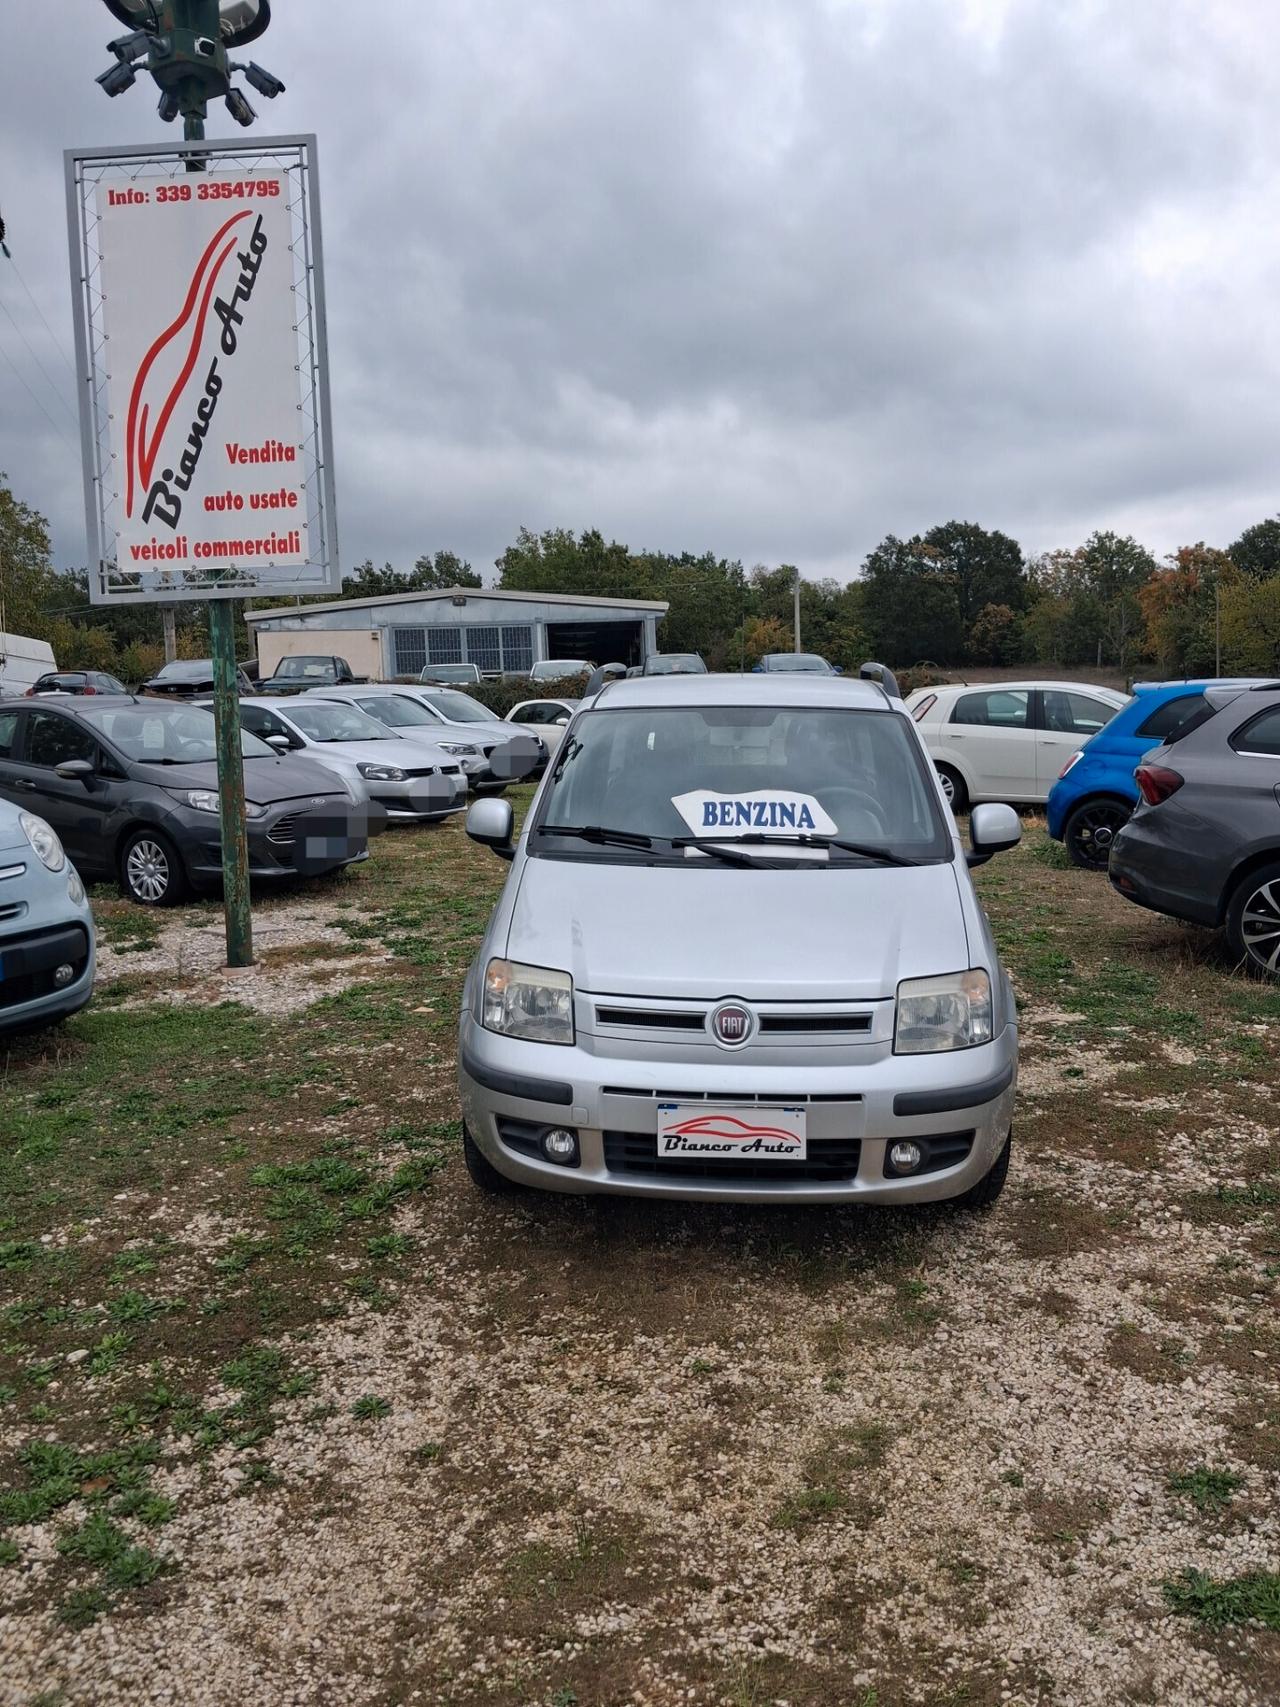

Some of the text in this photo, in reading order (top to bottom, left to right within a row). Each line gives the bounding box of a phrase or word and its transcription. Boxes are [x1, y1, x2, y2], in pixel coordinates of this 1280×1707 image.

[108, 180, 280, 206] Info: 339 3354795
[141, 214, 268, 530] Bianco Auto
[226, 440, 296, 464] Vendita
[204, 488, 298, 511] auto usate
[130, 531, 300, 560] veicoli commerciali
[702, 801, 816, 829] BENZINA
[722, 1016, 743, 1034] FIAT
[663, 1135, 801, 1153] Bianco Auto
